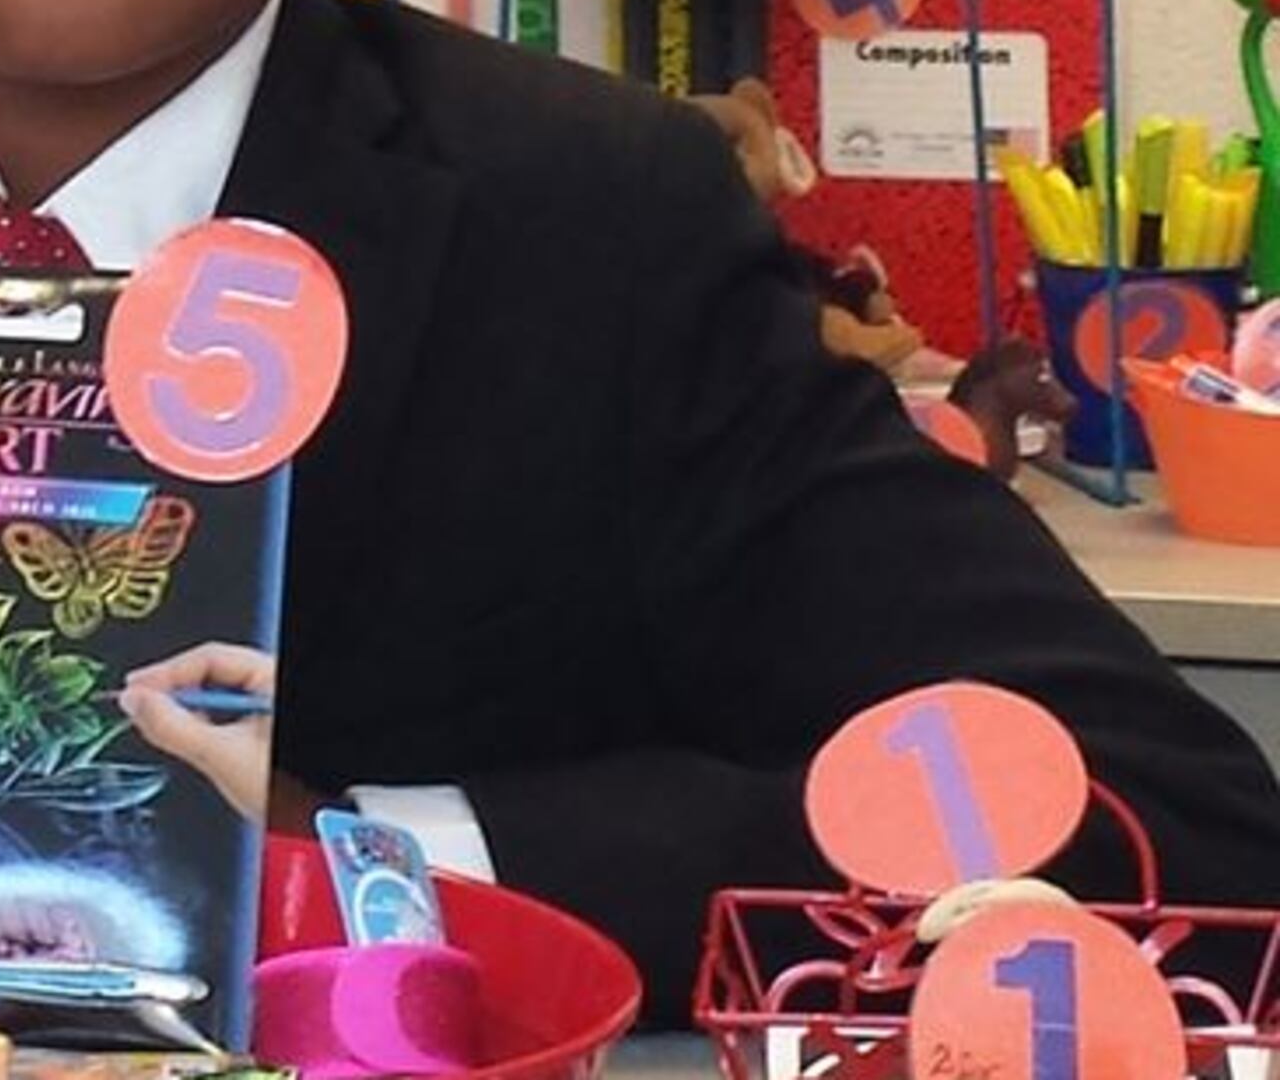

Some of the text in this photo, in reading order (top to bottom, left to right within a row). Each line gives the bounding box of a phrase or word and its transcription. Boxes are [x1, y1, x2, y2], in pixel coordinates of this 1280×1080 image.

[148, 252, 302, 454] 5
[885, 701, 1008, 885] 1
[993, 938, 1078, 1080] 1
